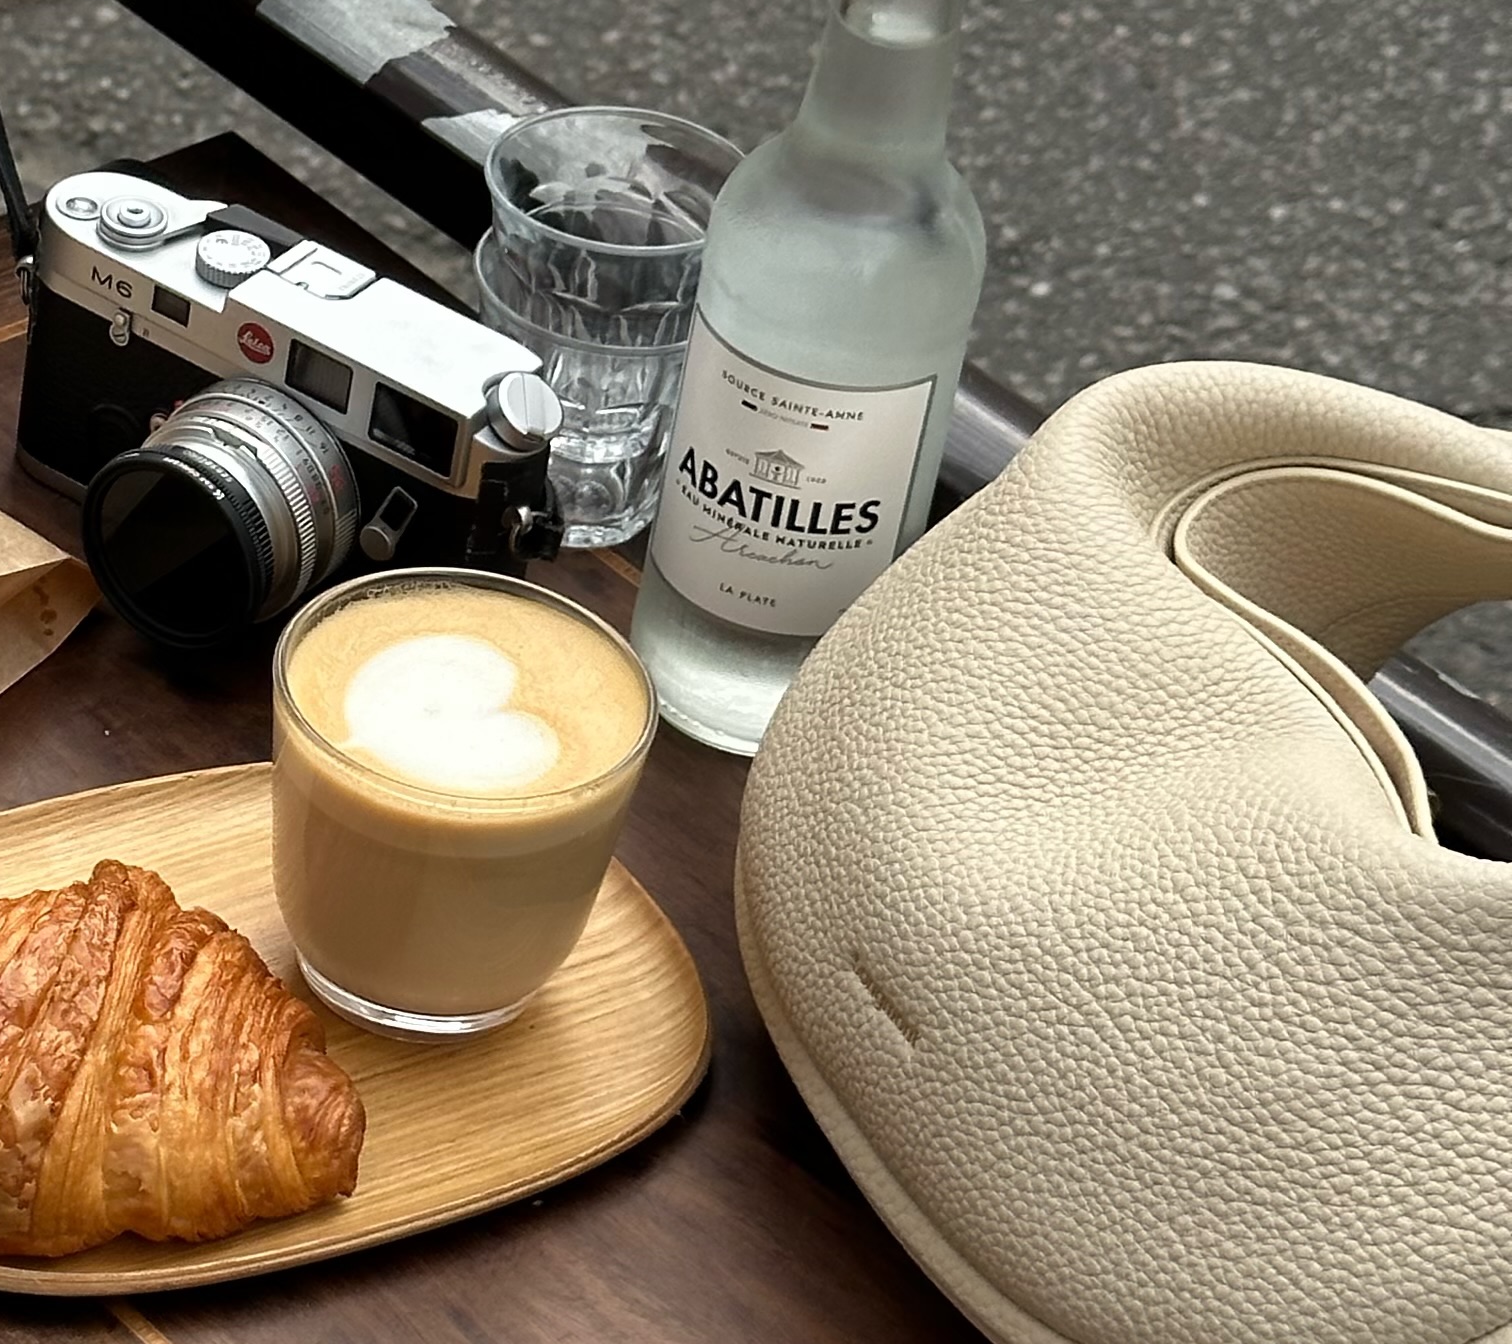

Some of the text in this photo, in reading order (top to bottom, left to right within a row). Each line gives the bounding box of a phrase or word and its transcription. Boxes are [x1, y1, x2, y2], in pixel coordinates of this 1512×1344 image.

[90, 266, 133, 299] M6
[721, 369, 766, 402] SOURCE
[770, 396, 865, 422] SAINTE-ANNE
[678, 445, 881, 535] ABATILLES
[681, 484, 699, 506] EAU
[775, 535, 863, 551] NATURELLE
[719, 581, 734, 595] LA
